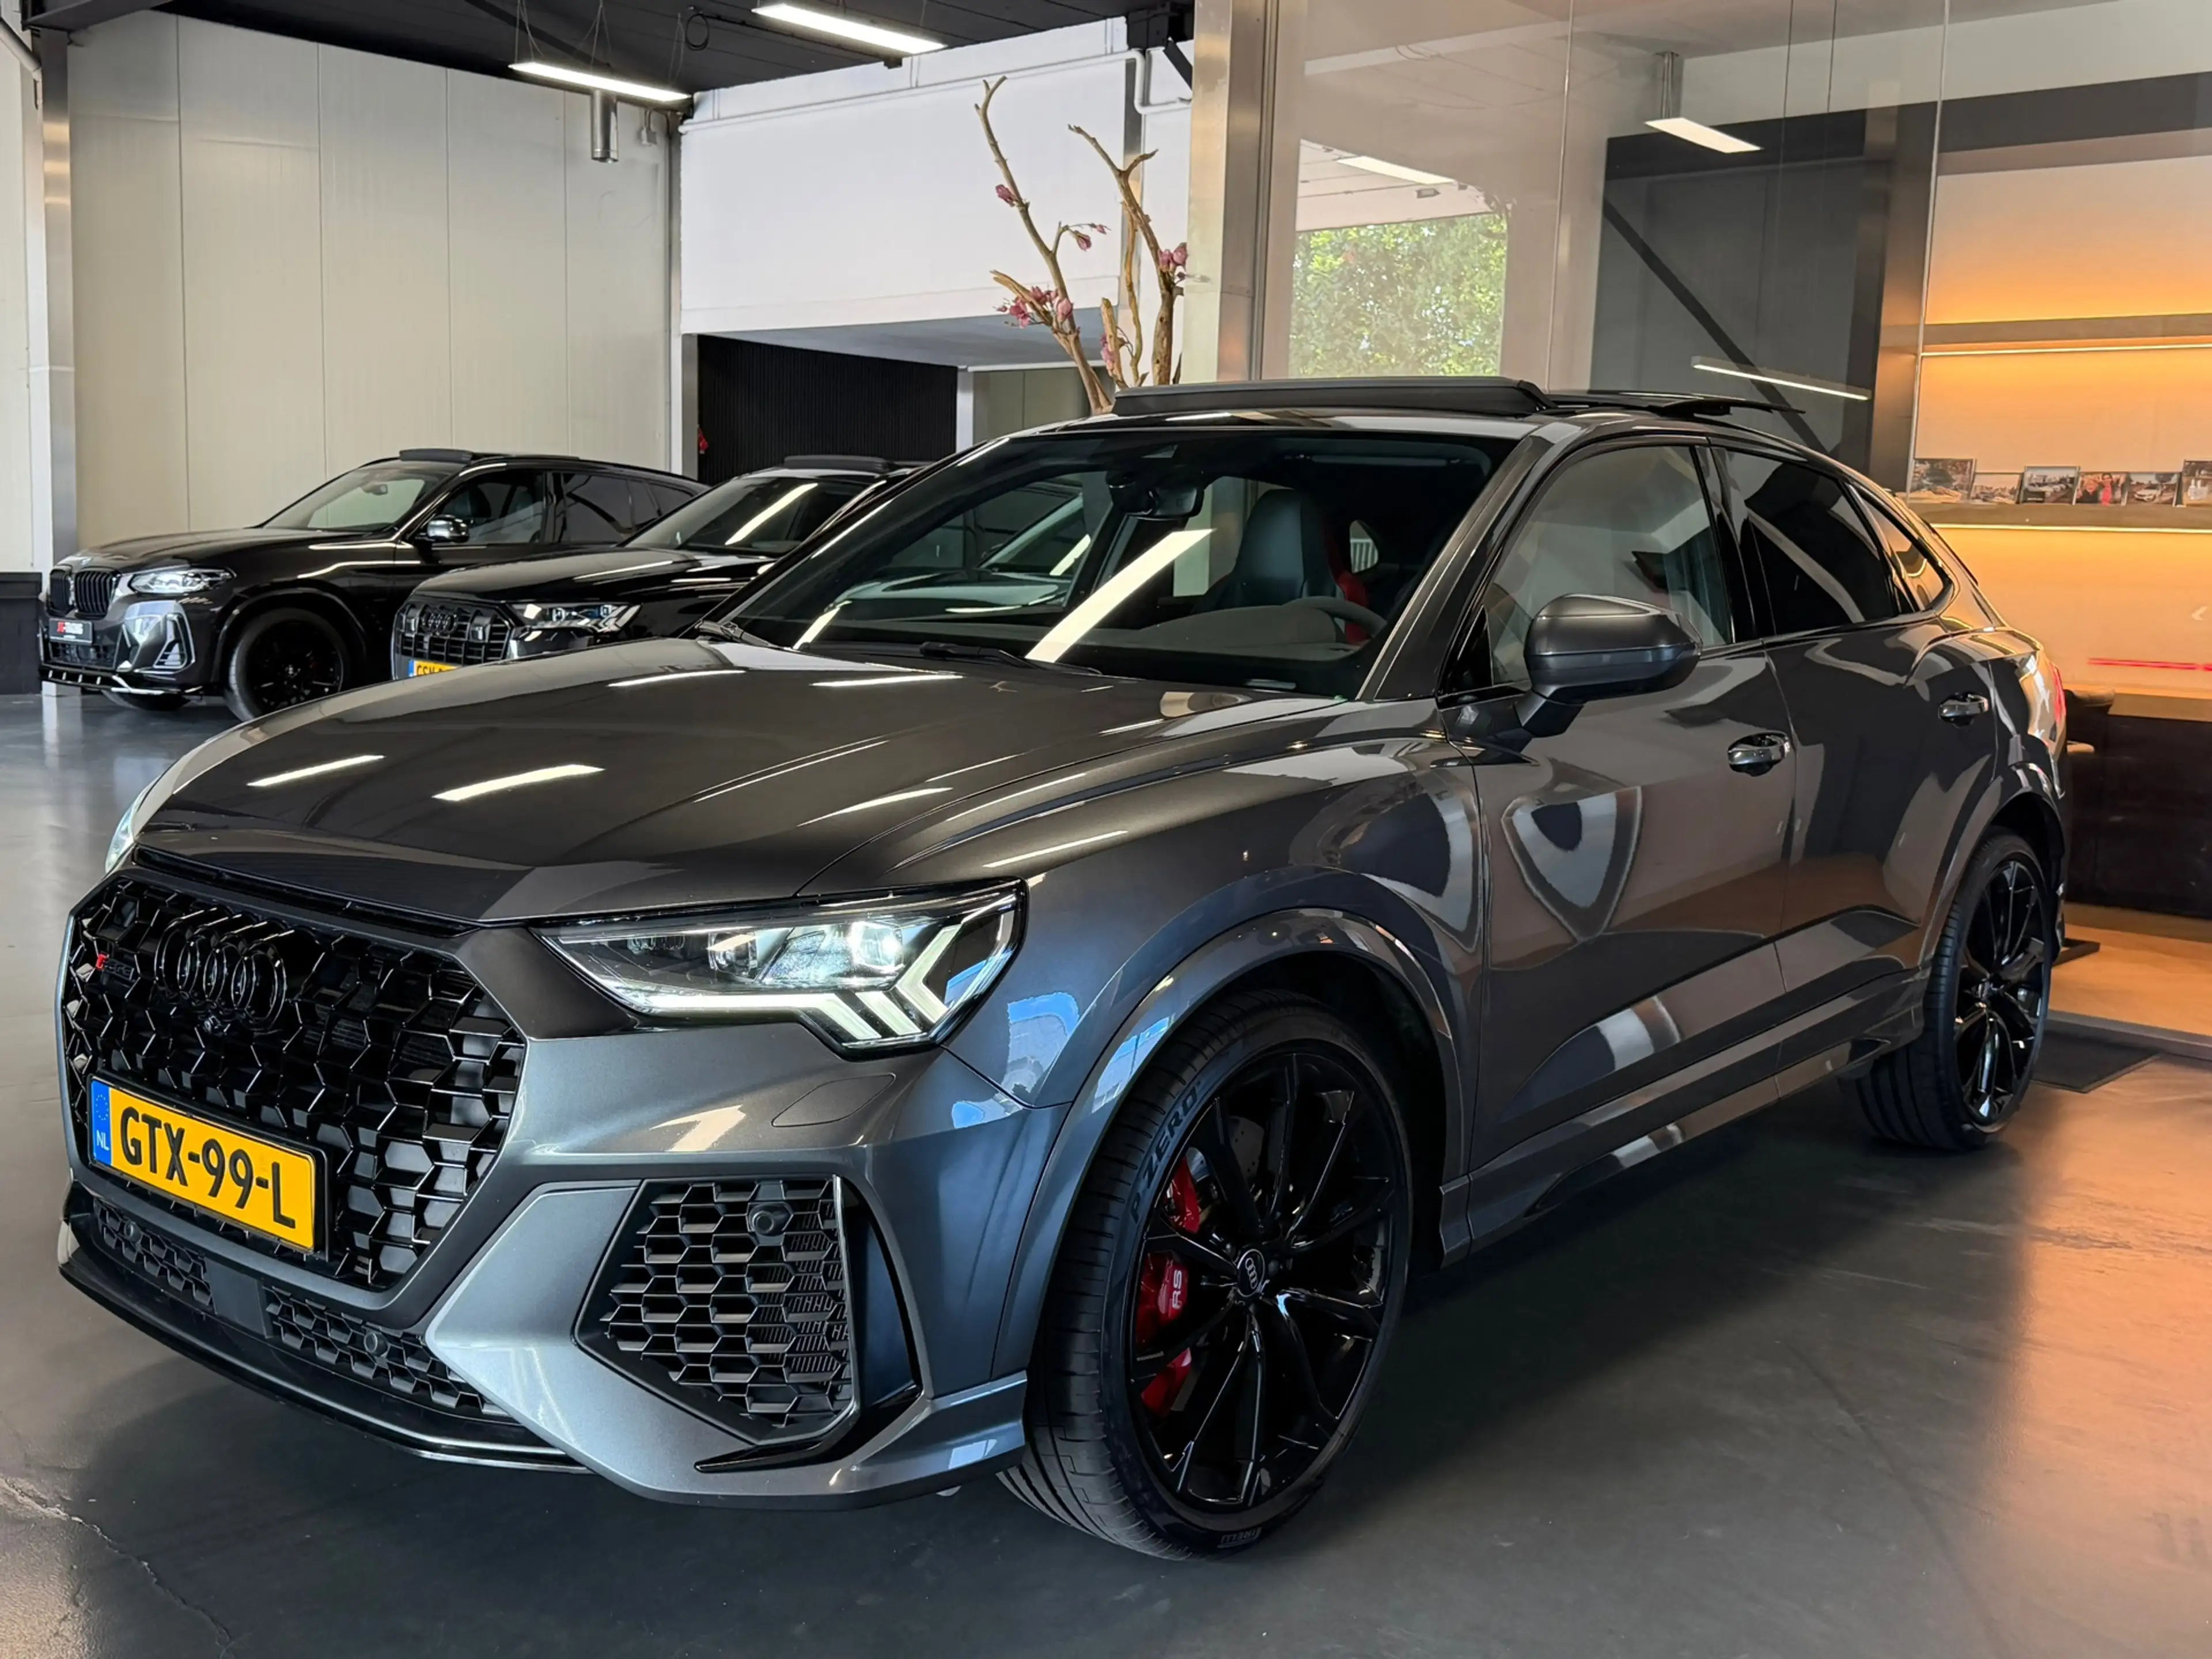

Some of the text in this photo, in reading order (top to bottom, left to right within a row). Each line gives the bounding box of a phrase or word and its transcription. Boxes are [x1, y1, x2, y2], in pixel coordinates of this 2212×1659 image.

[96, 1130, 109, 1151] NL
[120, 1106, 296, 1229] GTX-99-L
[1131, 1085, 1198, 1224] P ZERO
[1172, 1270, 1182, 1309] RS
